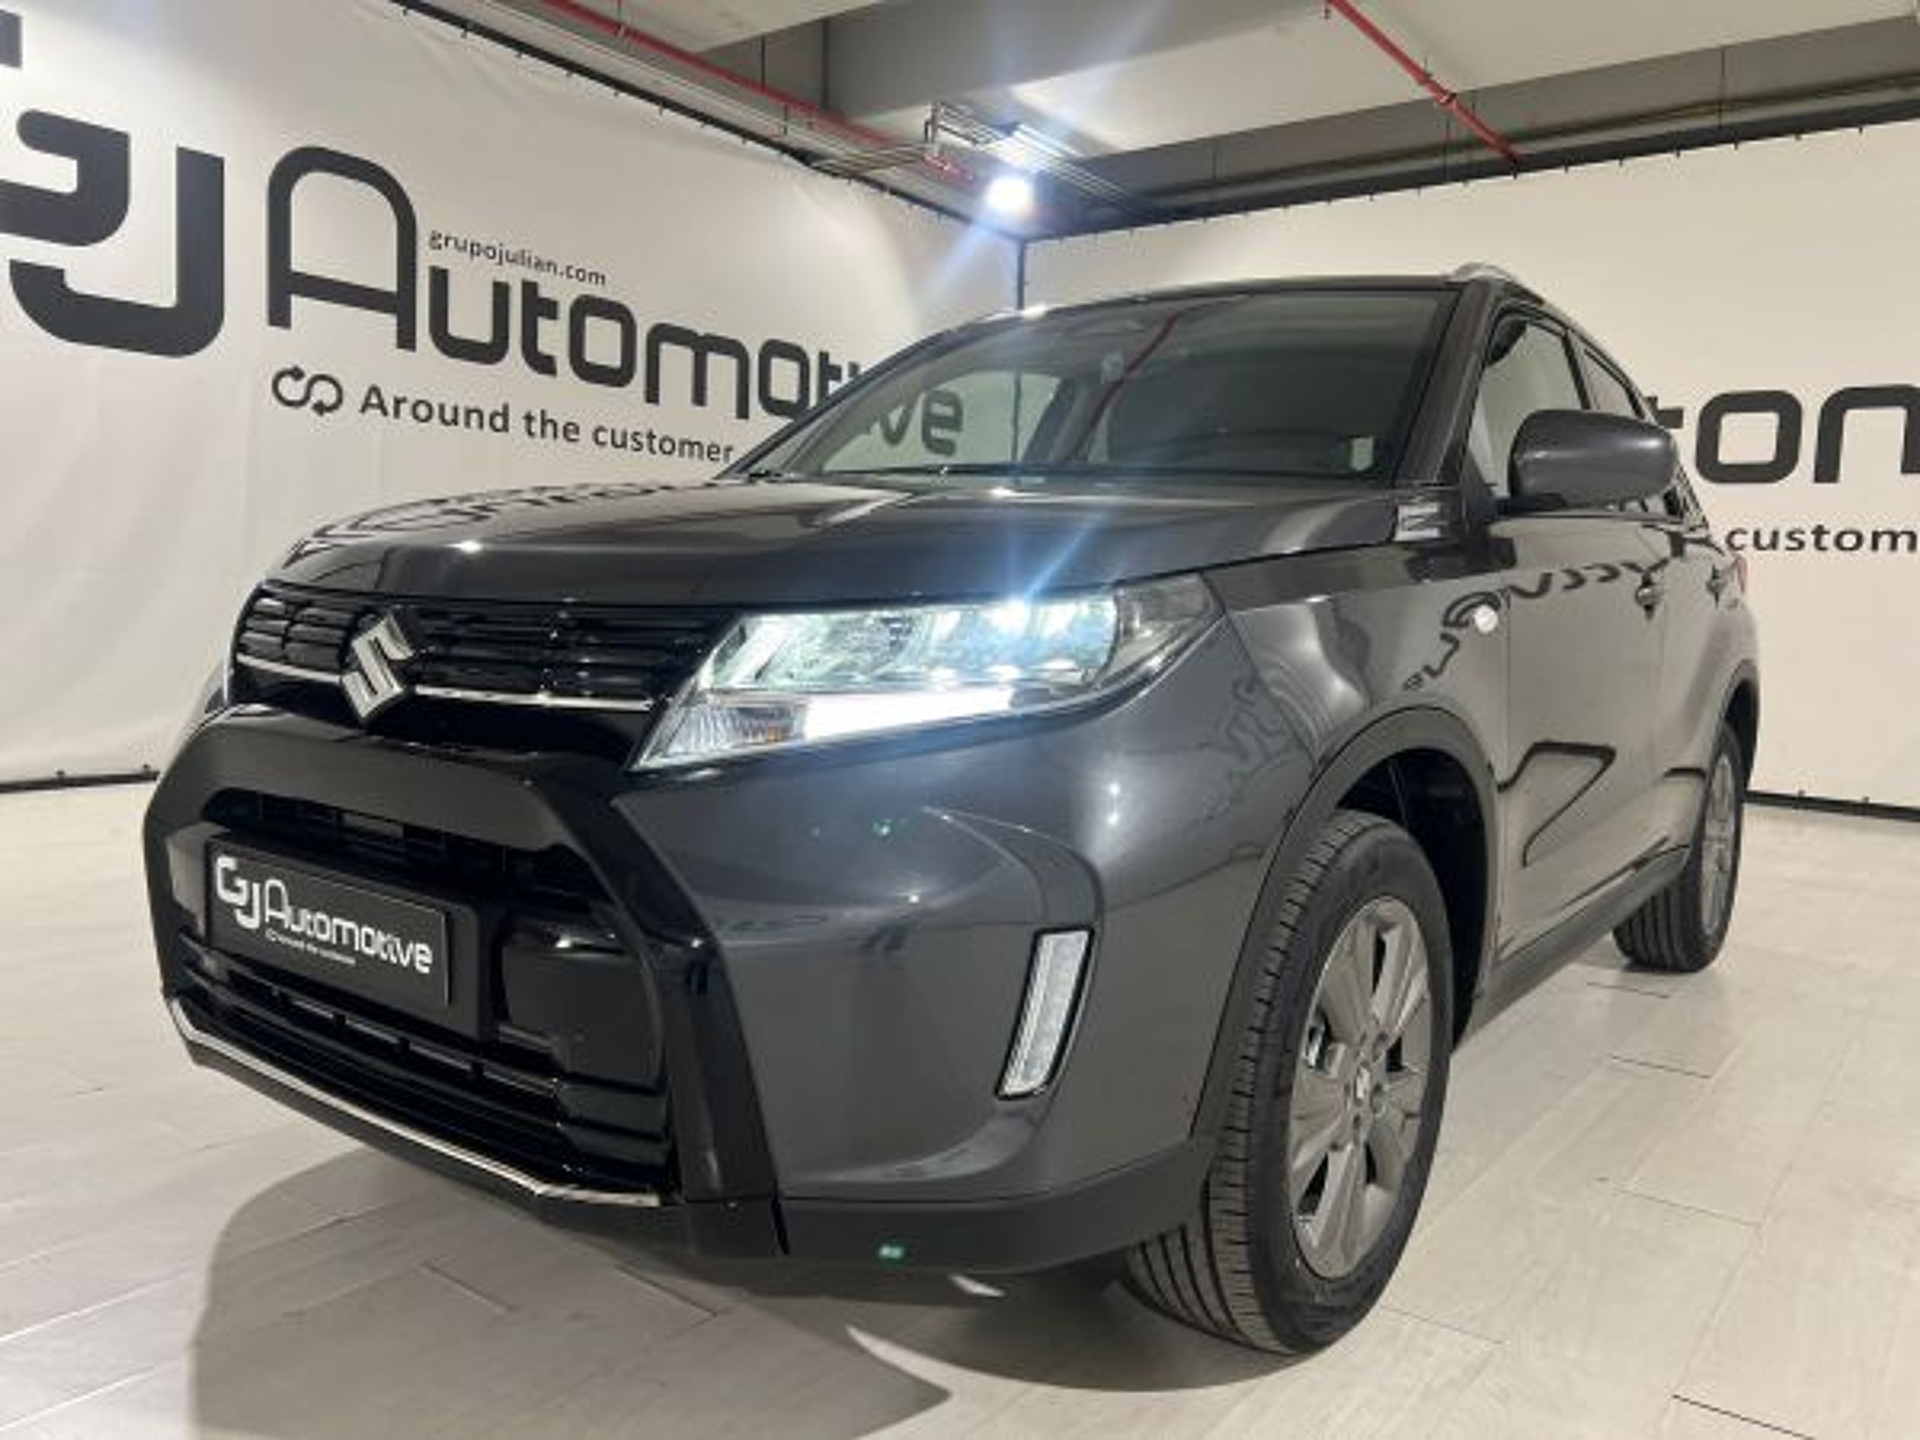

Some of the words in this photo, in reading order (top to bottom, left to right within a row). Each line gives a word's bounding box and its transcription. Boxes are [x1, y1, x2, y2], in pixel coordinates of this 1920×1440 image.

[428, 229, 606, 287] grupojulian.com
[266, 145, 964, 457] Automotve
[359, 384, 511, 434] Around
[523, 409, 581, 444] the
[591, 423, 735, 463] customer
[1723, 524, 1919, 552] custom
[264, 877, 434, 974] Automotive
